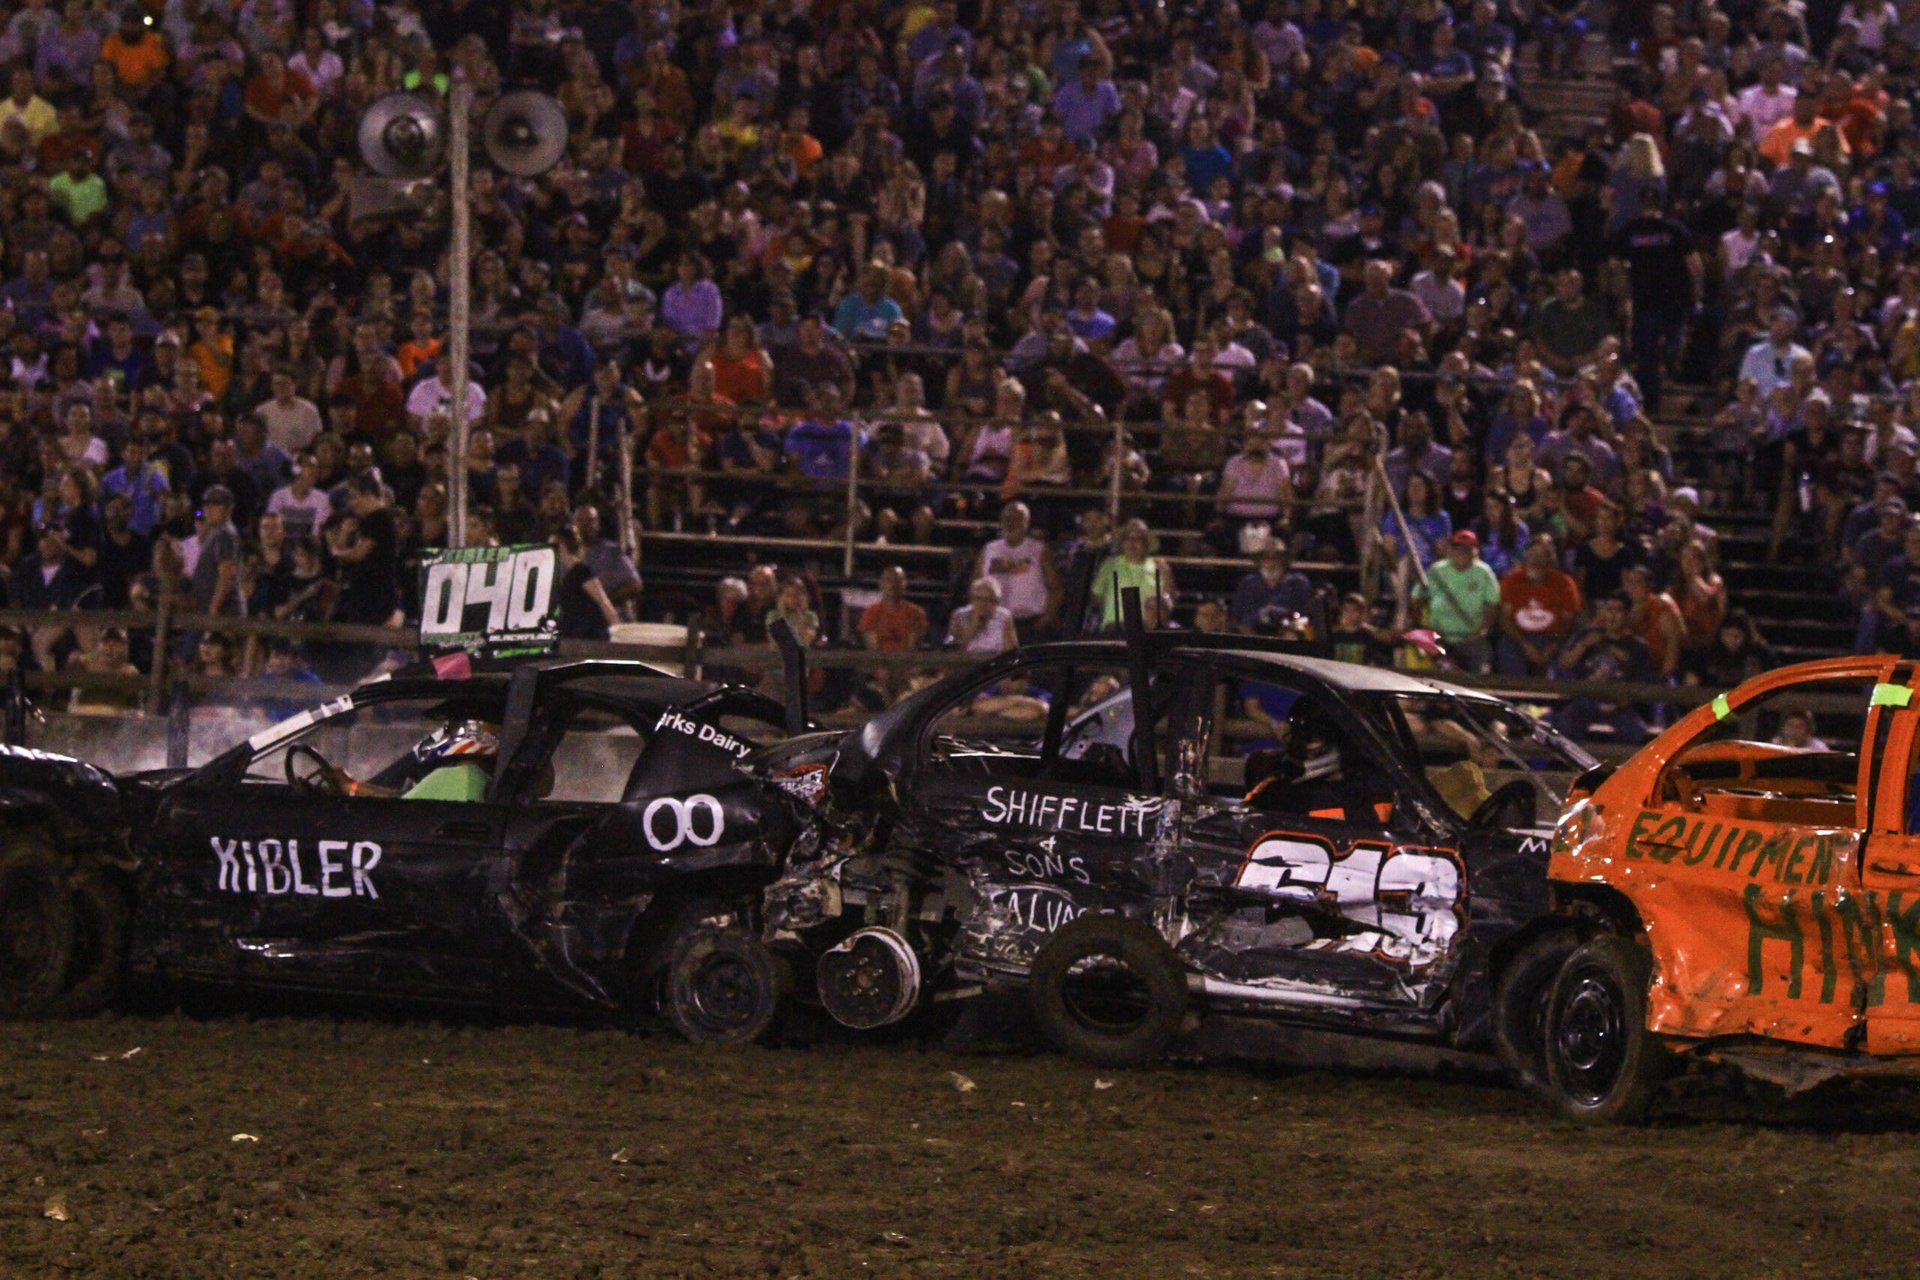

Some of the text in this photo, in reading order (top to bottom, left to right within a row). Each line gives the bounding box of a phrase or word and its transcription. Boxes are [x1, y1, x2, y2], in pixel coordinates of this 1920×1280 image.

[421, 548, 555, 633] 040
[698, 724, 751, 758] Dairy
[643, 794, 724, 851] 00
[983, 786, 1150, 837] SHIFFLETT
[1005, 850, 1090, 885] SONS
[991, 885, 1116, 933] ALVA
